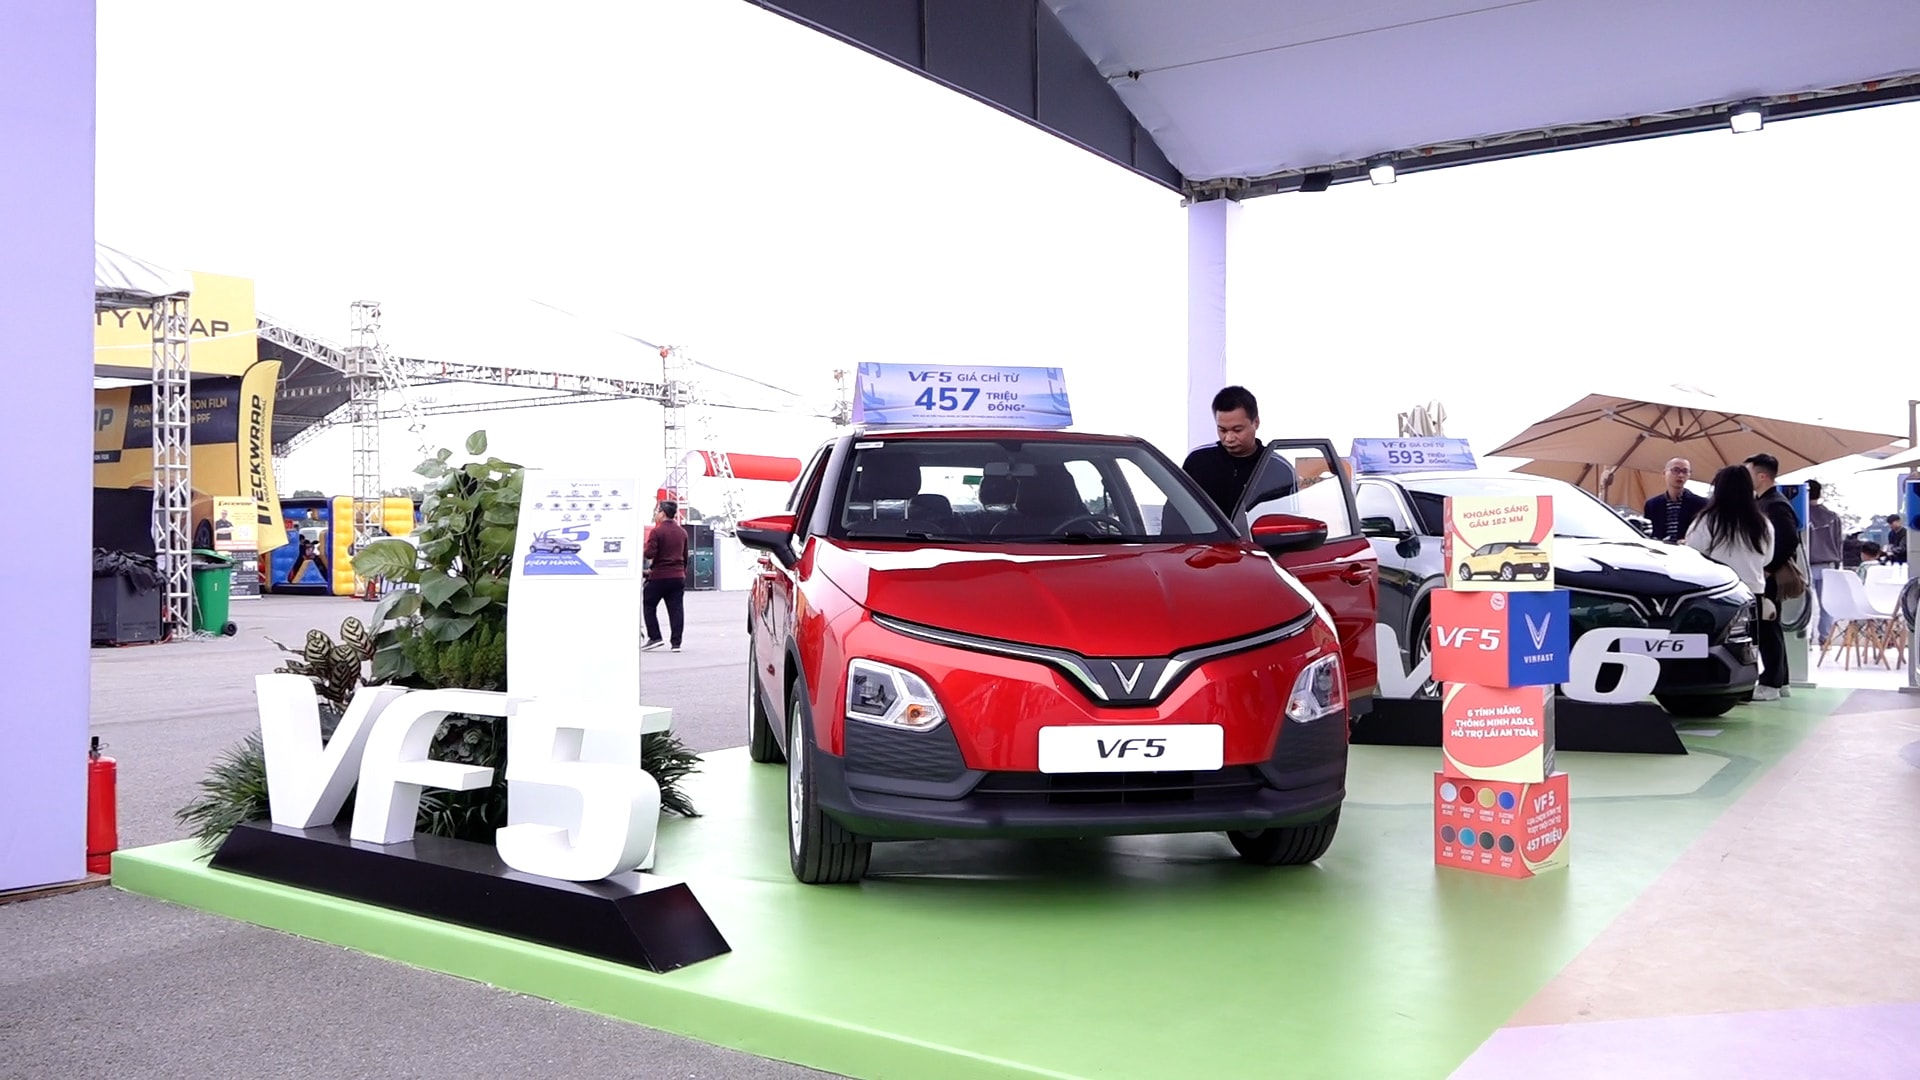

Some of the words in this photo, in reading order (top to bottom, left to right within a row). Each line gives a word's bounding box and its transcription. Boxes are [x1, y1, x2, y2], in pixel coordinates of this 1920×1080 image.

[957, 371, 977, 382] GIÁ
[981, 371, 1000, 382] CHỈ
[1003, 372, 1019, 383] TỪ
[208, 397, 227, 408] FILM
[915, 387, 980, 411] 457
[986, 391, 1018, 402] TRIỆU
[1388, 450, 1425, 464] 593
[1509, 515, 1524, 523] MM
[1645, 640, 1685, 653] VF6
[1523, 653, 1554, 664] VINFAST
[1467, 709, 1474, 717] 6
[1474, 707, 1495, 717] TÍNH
[1455, 718, 1485, 727] THÔNG
[1486, 718, 1510, 727] MINH
[1510, 717, 1534, 726] ADAS
[1499, 728, 1512, 737] AN
[1097, 738, 1167, 759] VF5
[1526, 837, 1540, 852] 457
